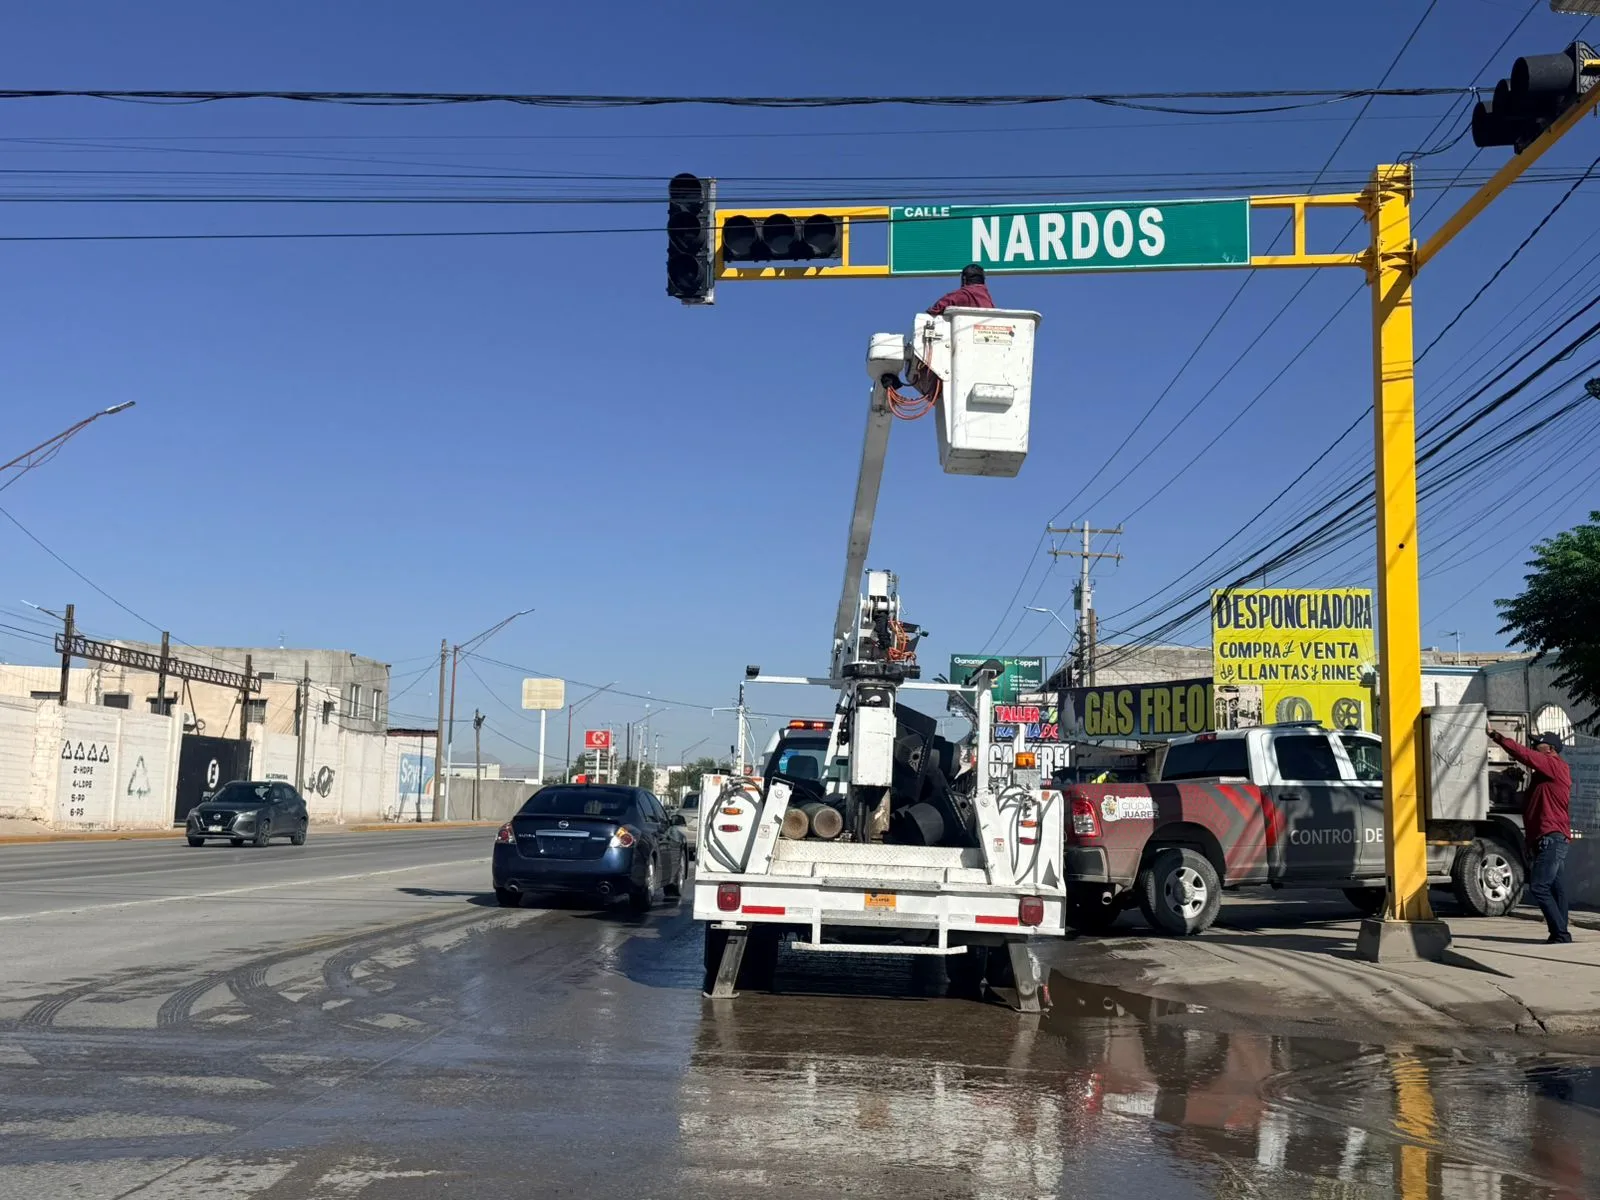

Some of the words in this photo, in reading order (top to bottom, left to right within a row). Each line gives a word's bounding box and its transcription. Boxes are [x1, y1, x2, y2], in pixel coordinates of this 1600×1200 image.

[904, 207, 950, 218] CALLE
[971, 207, 1166, 262] NARDOS
[1216, 594, 1373, 629] DESPONCHADORA
[1219, 641, 1281, 658] COMPRA
[1300, 642, 1359, 659] VENTA
[1220, 664, 1234, 681] de
[1238, 664, 1309, 680] LLANTAS
[1322, 664, 1363, 680] RINES
[995, 705, 1040, 723] TALLER
[1084, 690, 1135, 736] GAS
[72, 780, 93, 788] 4-LDPE
[71, 794, 85, 802] 5-PP
[70, 808, 84, 816] 6-PS
[1290, 828, 1360, 845] CONTROL
[1365, 828, 1384, 843] DE
